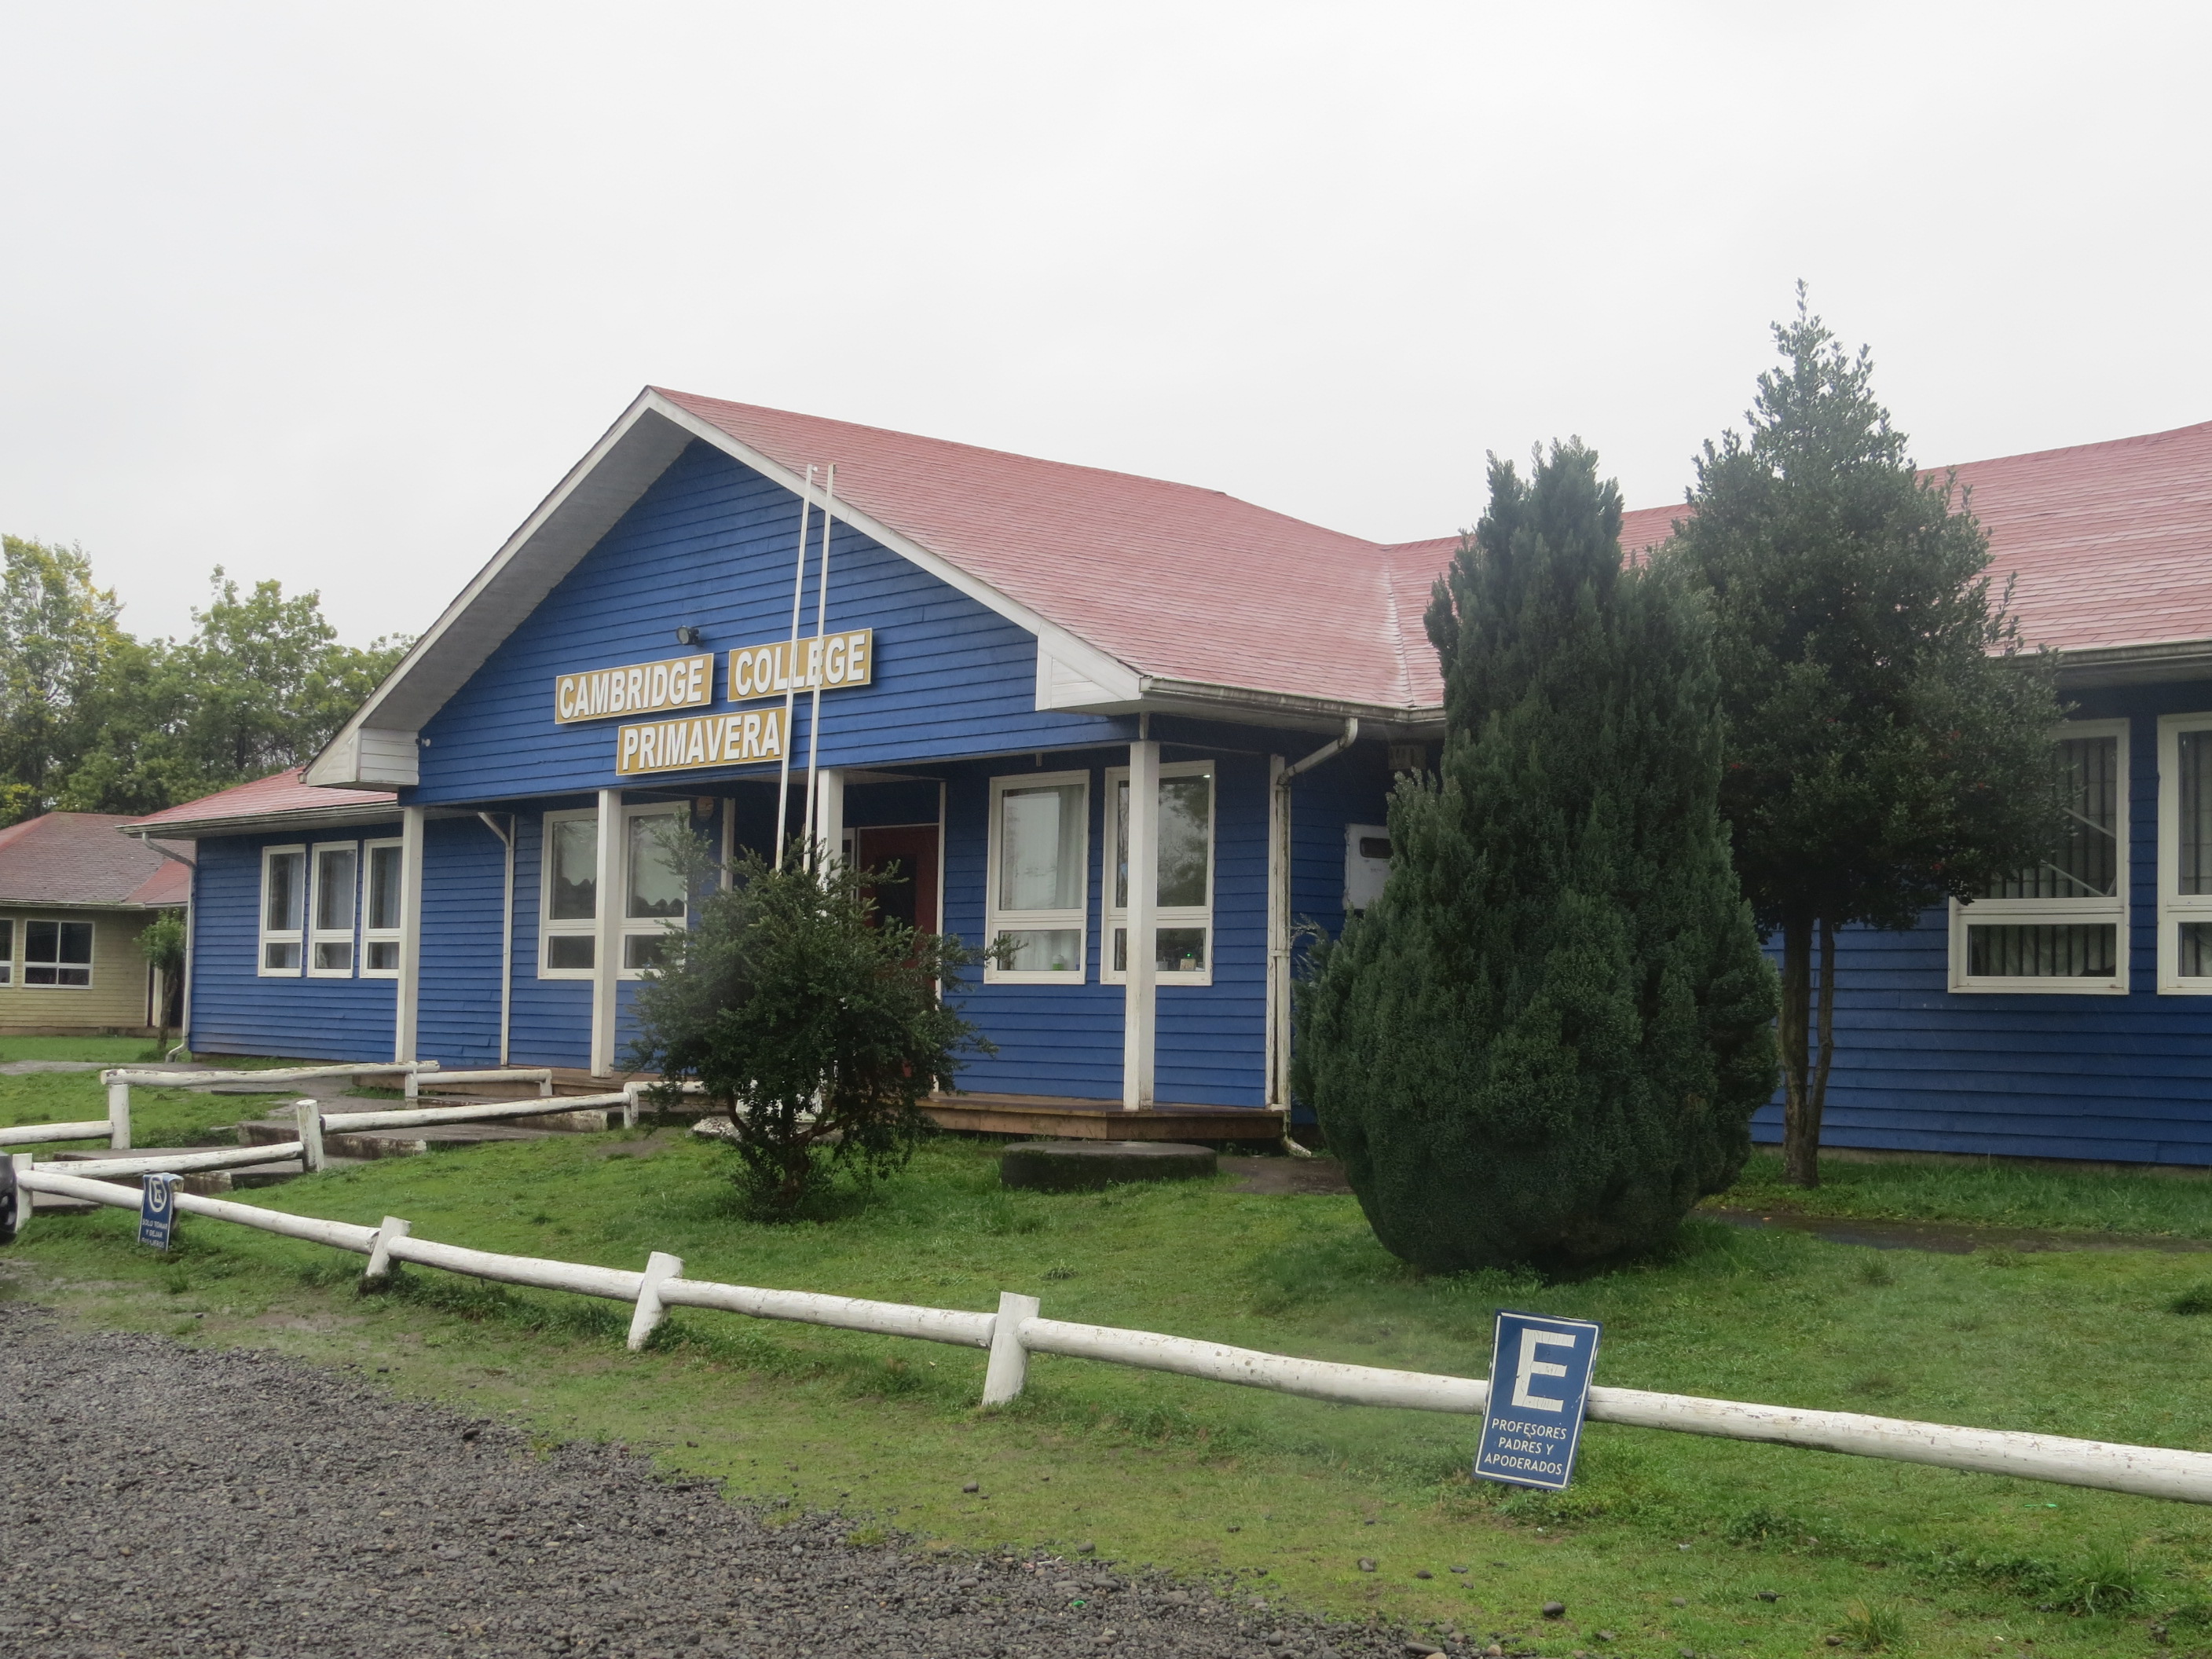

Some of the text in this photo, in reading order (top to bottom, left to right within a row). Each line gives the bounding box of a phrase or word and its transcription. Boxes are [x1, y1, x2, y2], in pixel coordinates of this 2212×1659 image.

[559, 634, 866, 720] CAMBRIDGE COLLEGE
[622, 711, 781, 771] PRIMAVERA
[1511, 1328, 1576, 1412] E
[1492, 1418, 1567, 1440] PROFESORES
[1498, 1437, 1555, 1456] PADRES Y
[1484, 1452, 1563, 1475] APODERADOS
